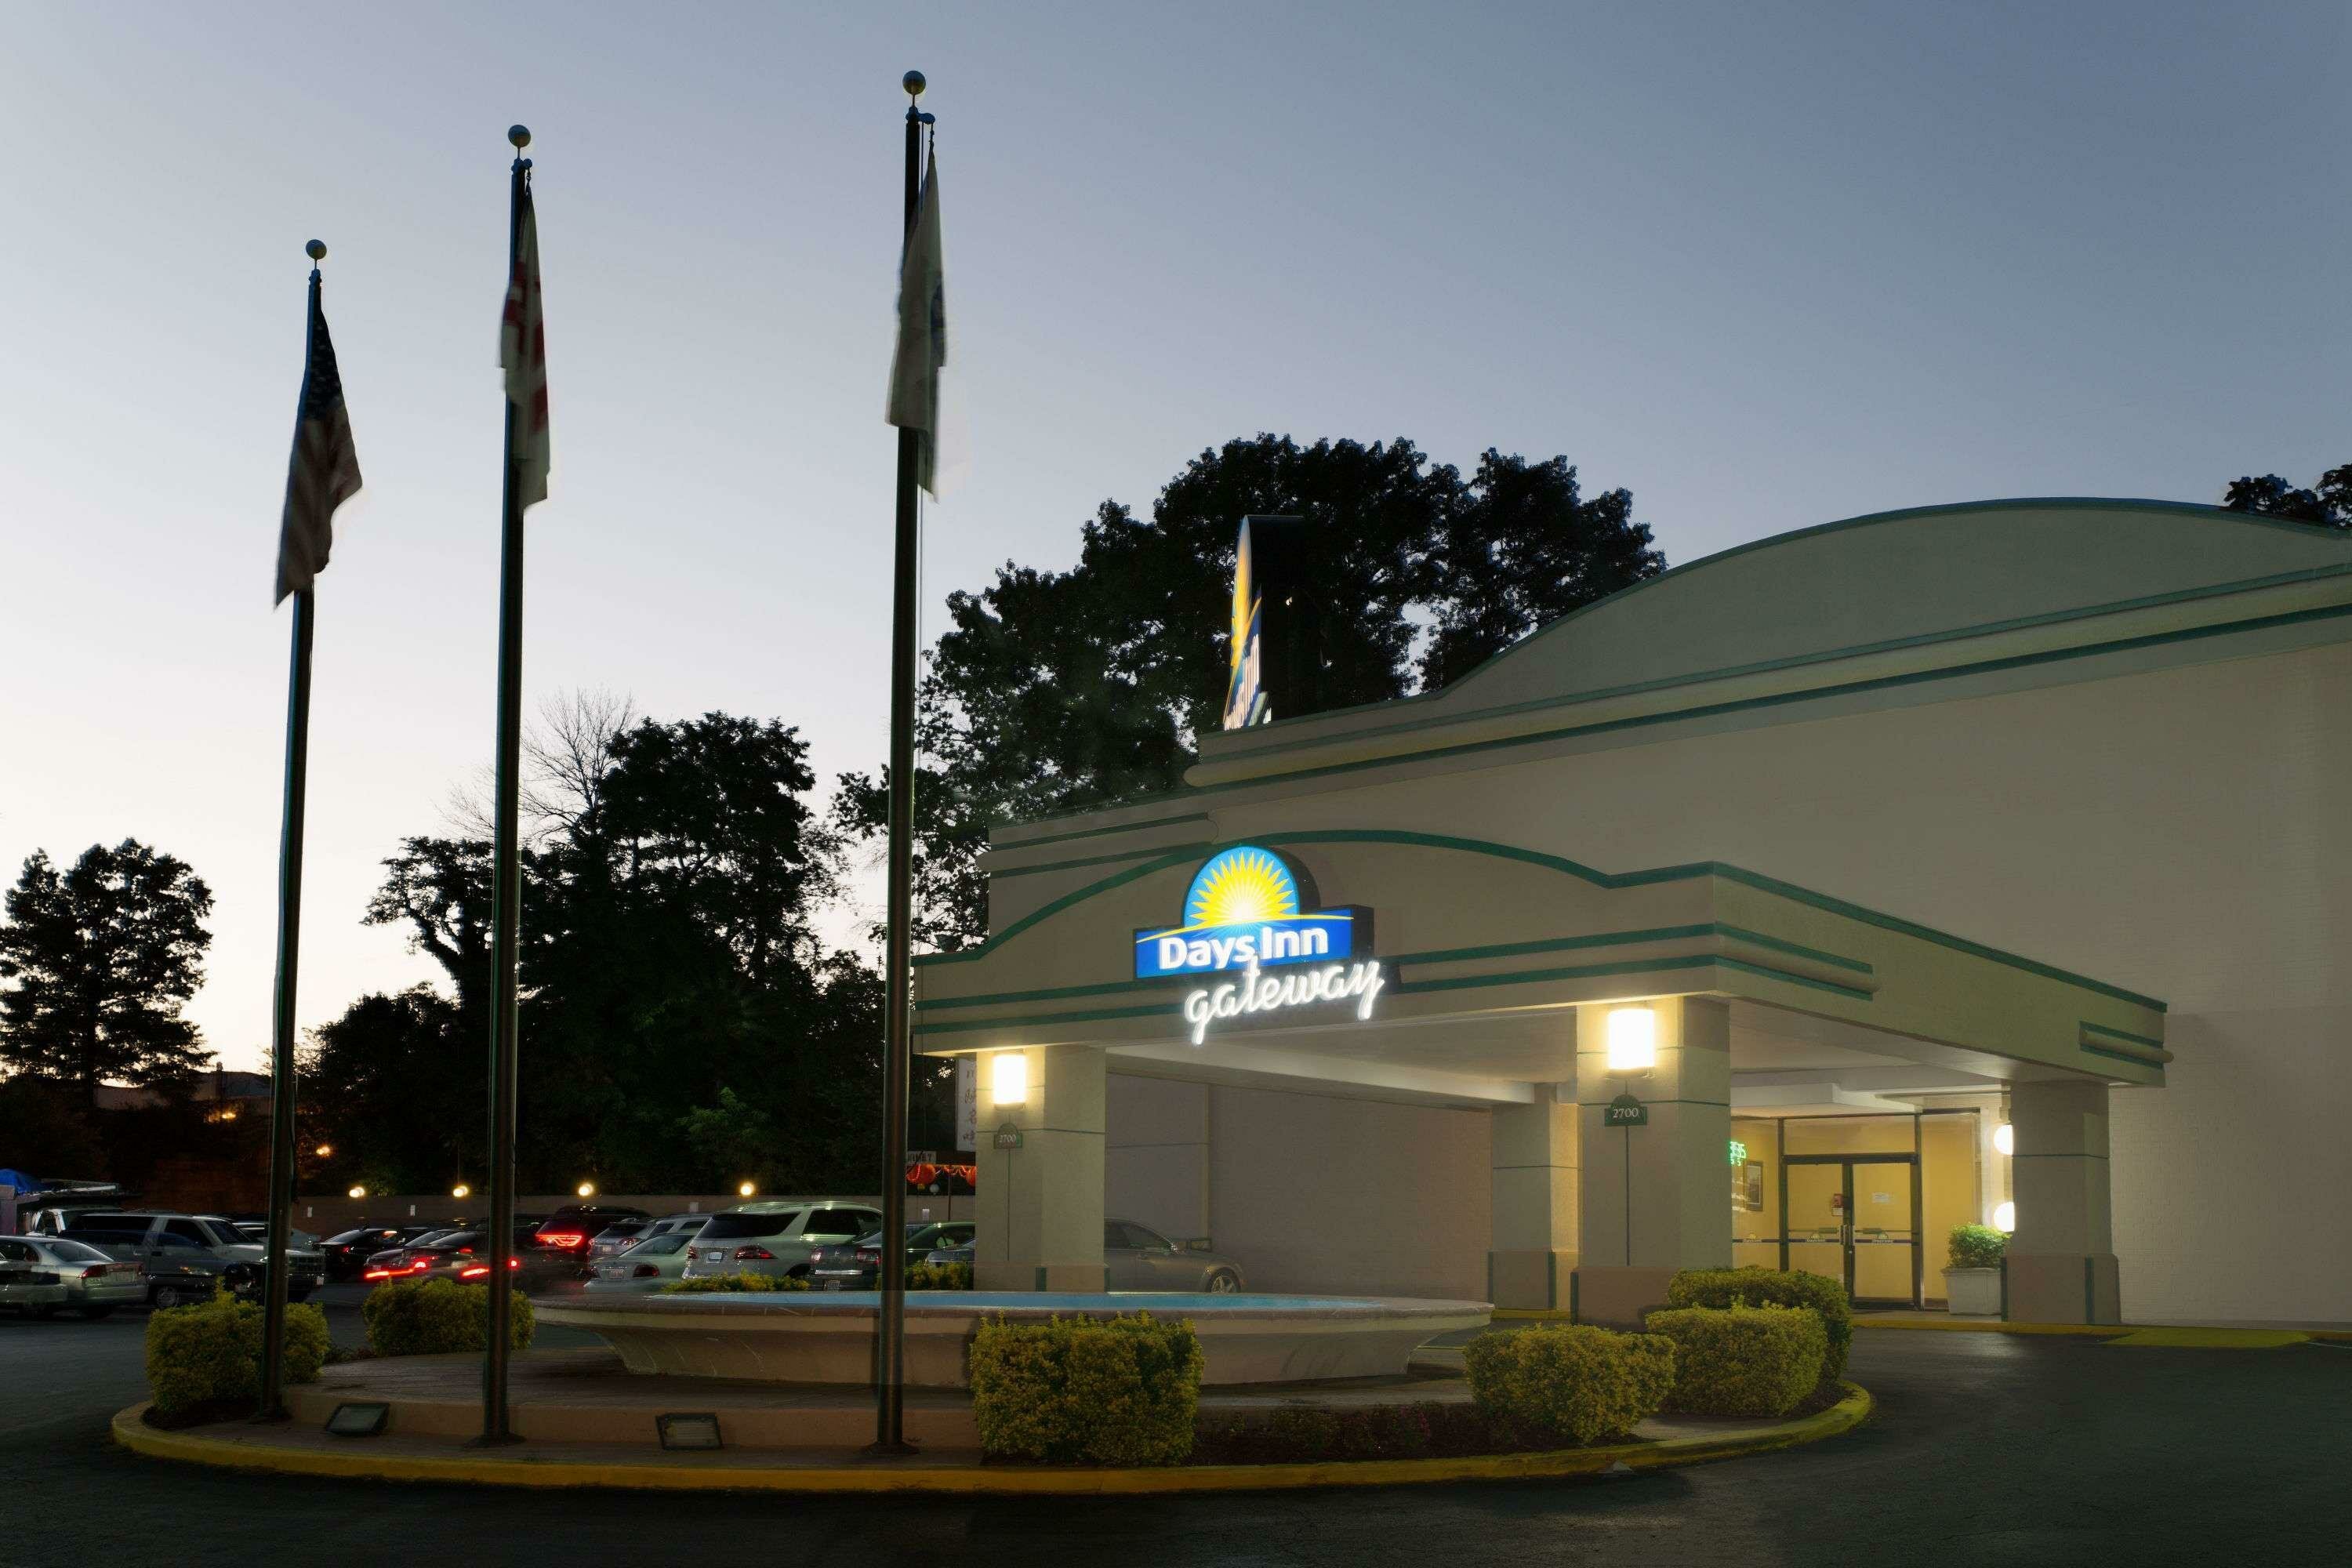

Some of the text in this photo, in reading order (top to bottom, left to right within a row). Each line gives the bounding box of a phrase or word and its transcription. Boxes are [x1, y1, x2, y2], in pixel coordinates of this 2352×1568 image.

[1158, 926, 1329, 970] Days Inn
[1184, 953, 1385, 1045] gateway
[1612, 1107, 1639, 1119] 2700
